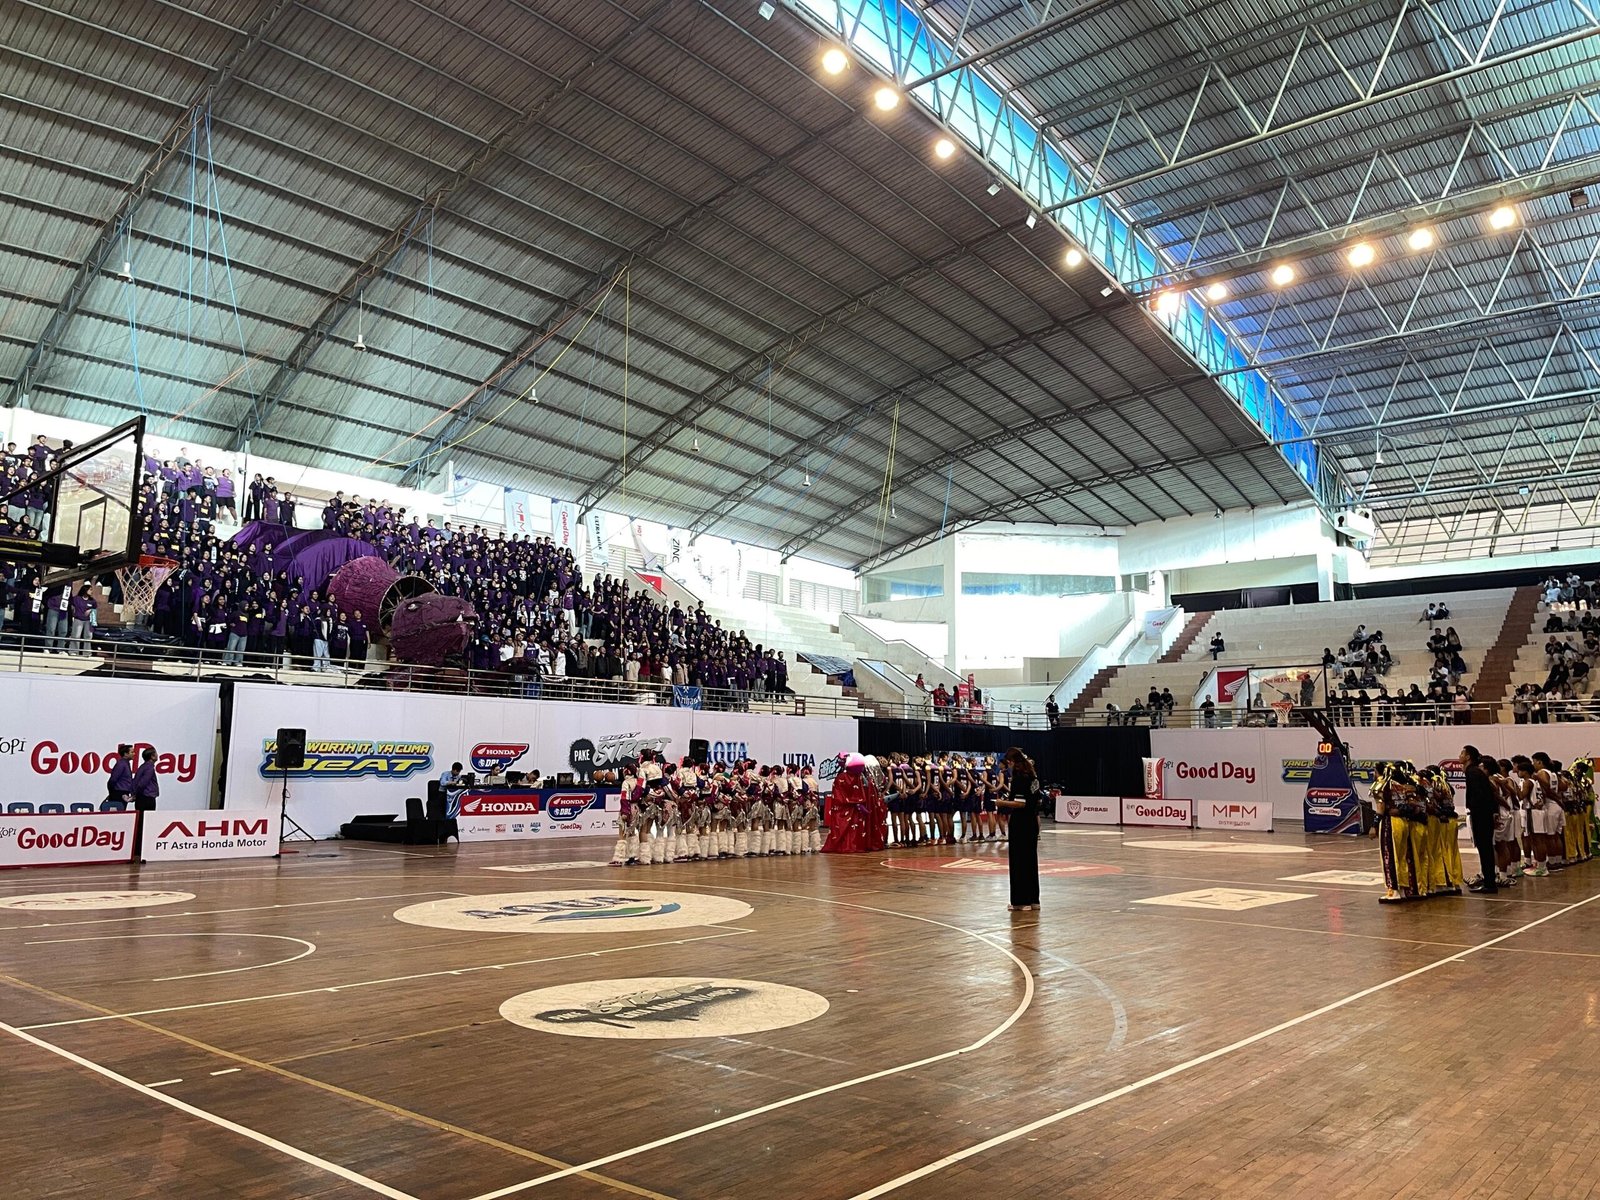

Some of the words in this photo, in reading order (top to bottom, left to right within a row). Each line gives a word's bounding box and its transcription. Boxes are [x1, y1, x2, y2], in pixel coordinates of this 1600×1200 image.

[672, 538, 680, 563] ZINC
[307, 741, 358, 754] WORTH
[377, 744, 395, 755] YA
[395, 744, 431, 755] CUMA
[1319, 743, 1332, 753] 00
[574, 749, 591, 762] PAKE
[783, 753, 815, 767] ULTRA
[1176, 761, 1218, 779] Good
[1222, 762, 1256, 784] Day
[481, 802, 536, 812] HONDA
[1136, 805, 1163, 817] Good
[1165, 806, 1187, 821] Day
[1212, 804, 1257, 819] MPM
[157, 819, 268, 838] AHM
[17, 827, 79, 850] Good
[81, 825, 125, 851] Day
[155, 842, 168, 850] PT
[171, 841, 198, 850] Astra
[201, 839, 234, 849] Honda
[236, 839, 267, 848] Motor
